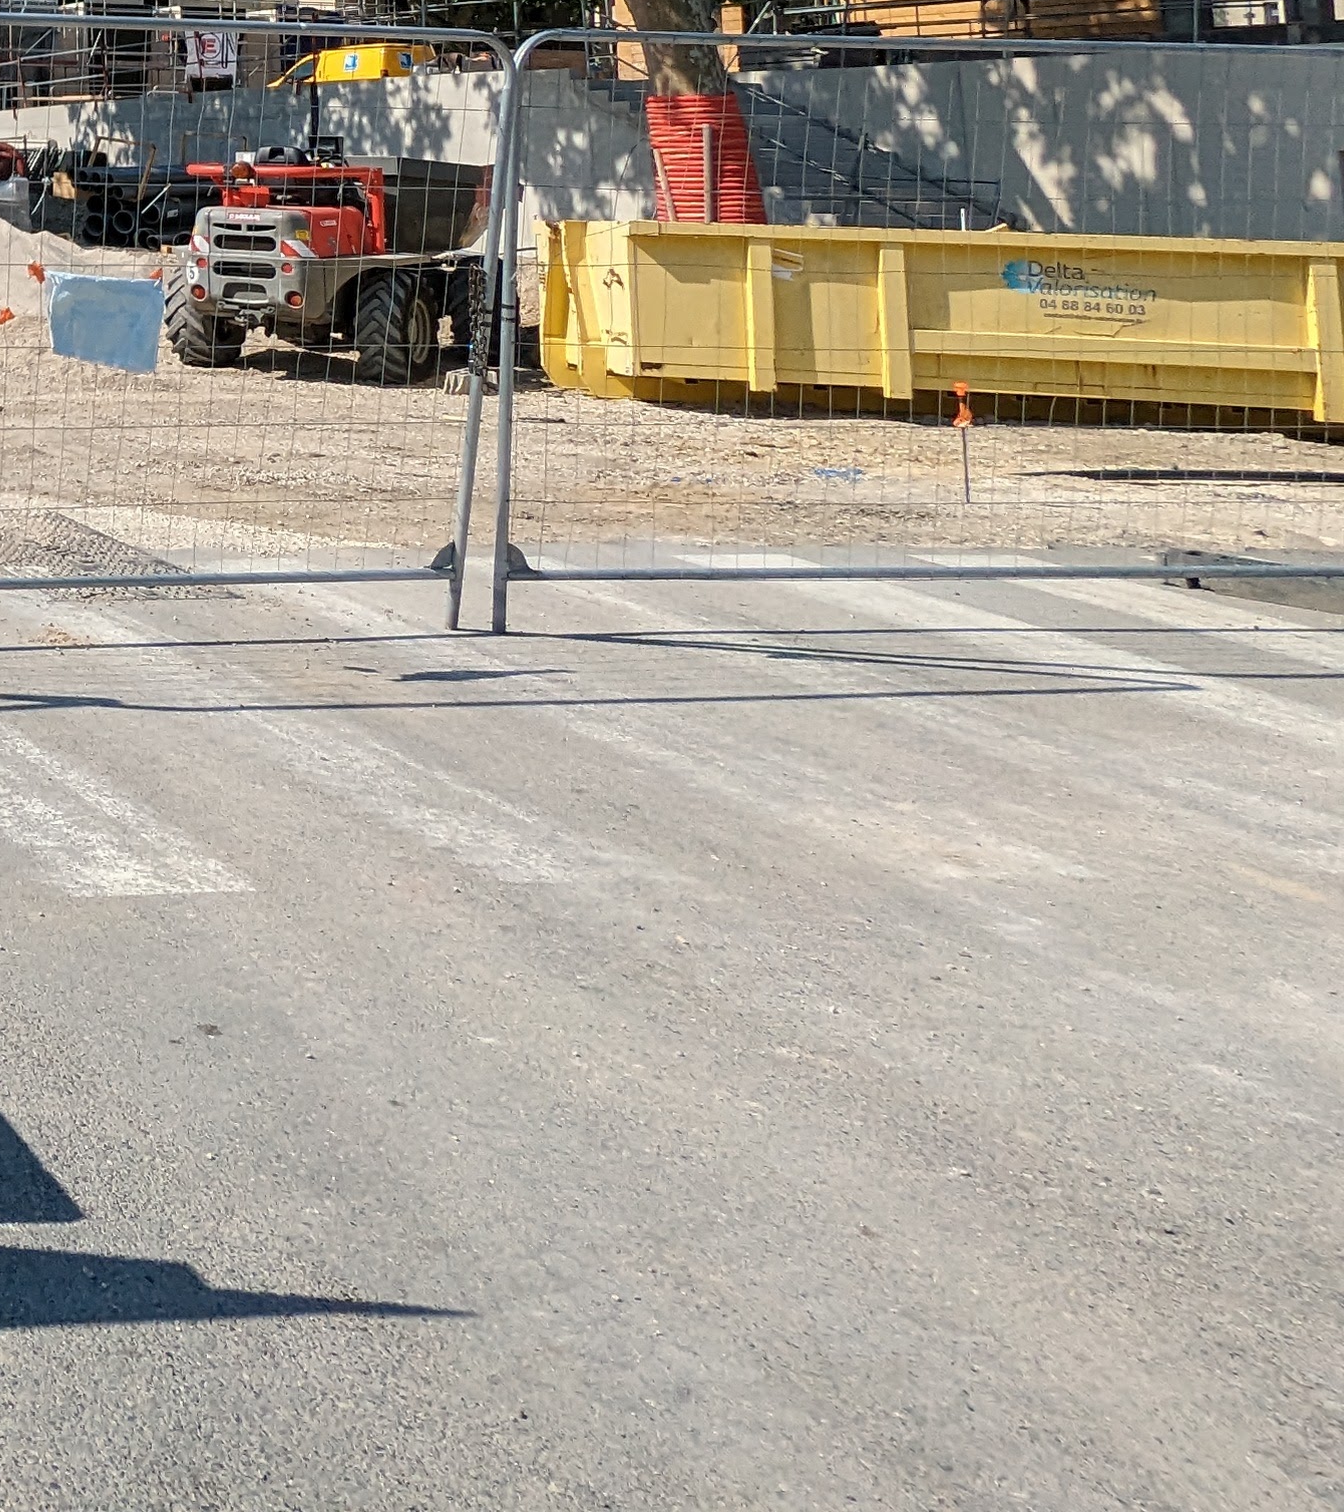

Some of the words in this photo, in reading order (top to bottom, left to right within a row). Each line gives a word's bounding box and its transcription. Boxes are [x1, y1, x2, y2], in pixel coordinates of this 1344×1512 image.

[1027, 260, 1085, 280] Delta
[1027, 277, 1157, 302] Valorisation
[1040, 298, 1057, 309] 04
[1083, 301, 1101, 313] 84
[1128, 304, 1146, 316] 03
